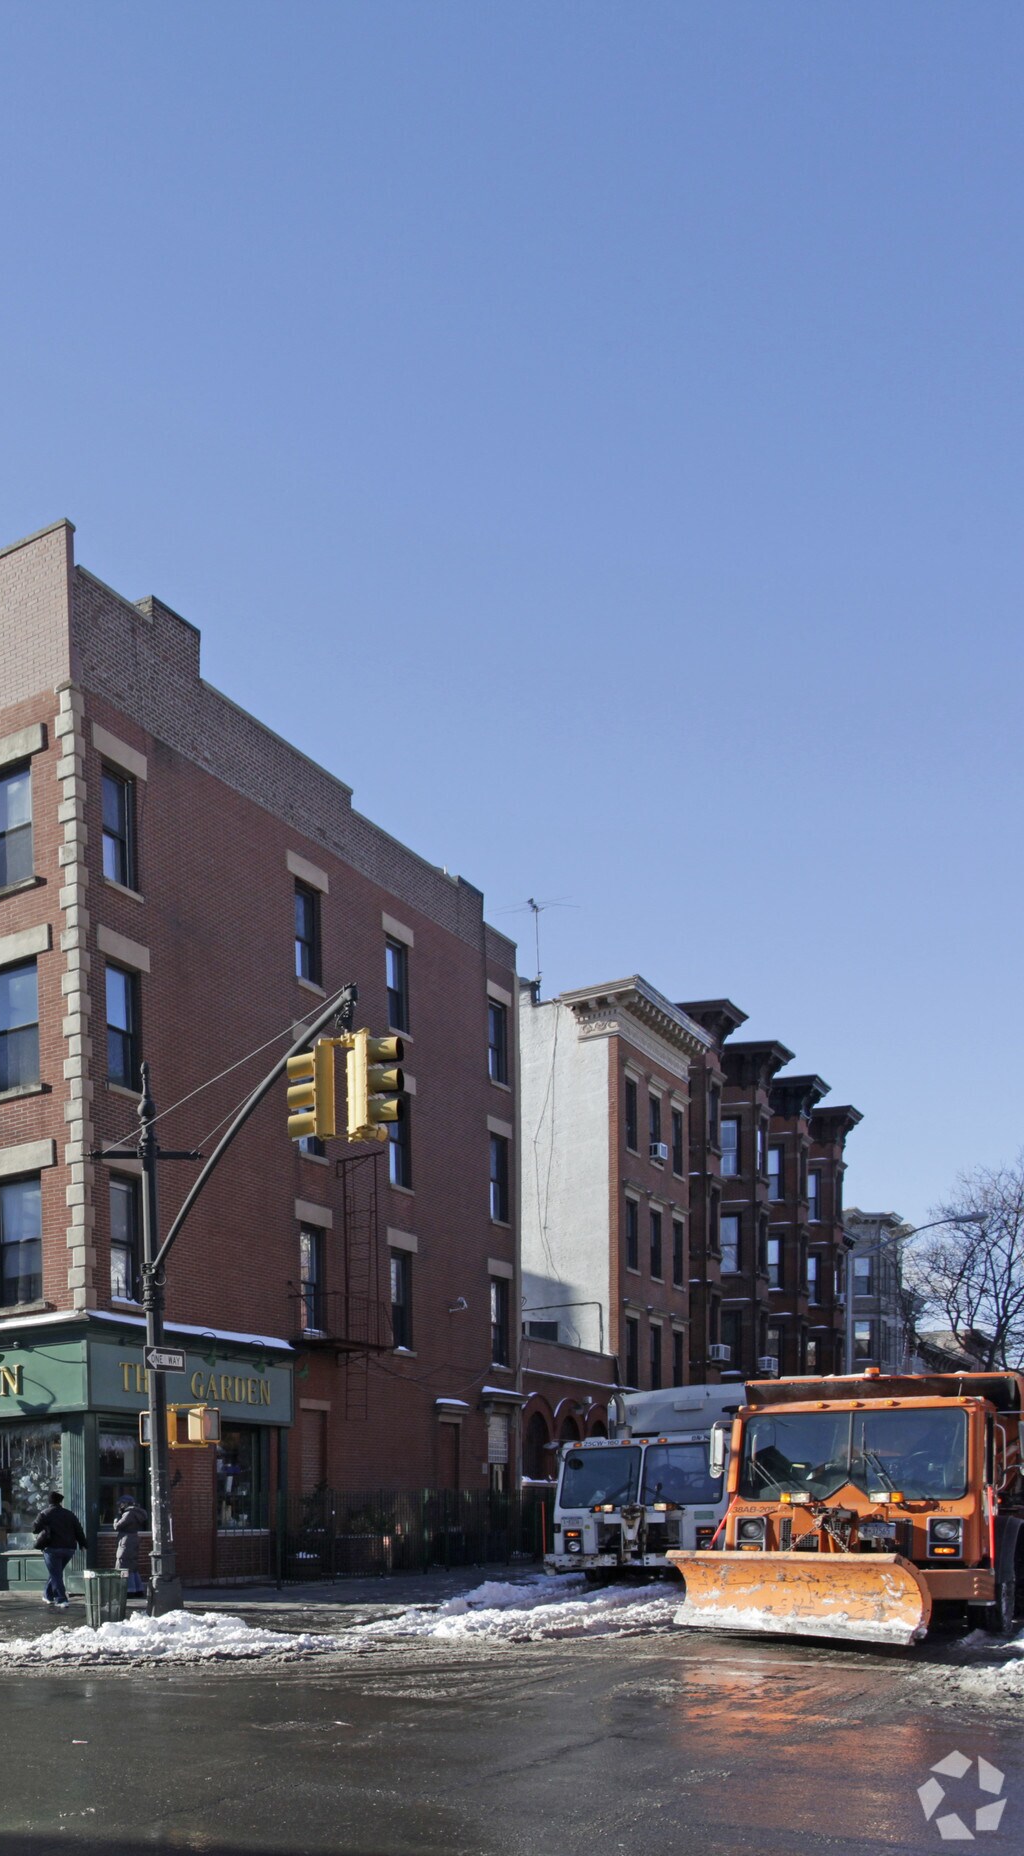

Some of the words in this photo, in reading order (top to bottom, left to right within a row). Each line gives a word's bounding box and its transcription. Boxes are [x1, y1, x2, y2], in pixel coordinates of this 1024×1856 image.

[151, 1354, 163, 1364] ONE
[168, 1356, 181, 1366] WAY
[119, 1362, 149, 1393] TH
[191, 1371, 271, 1406] GARDEN
